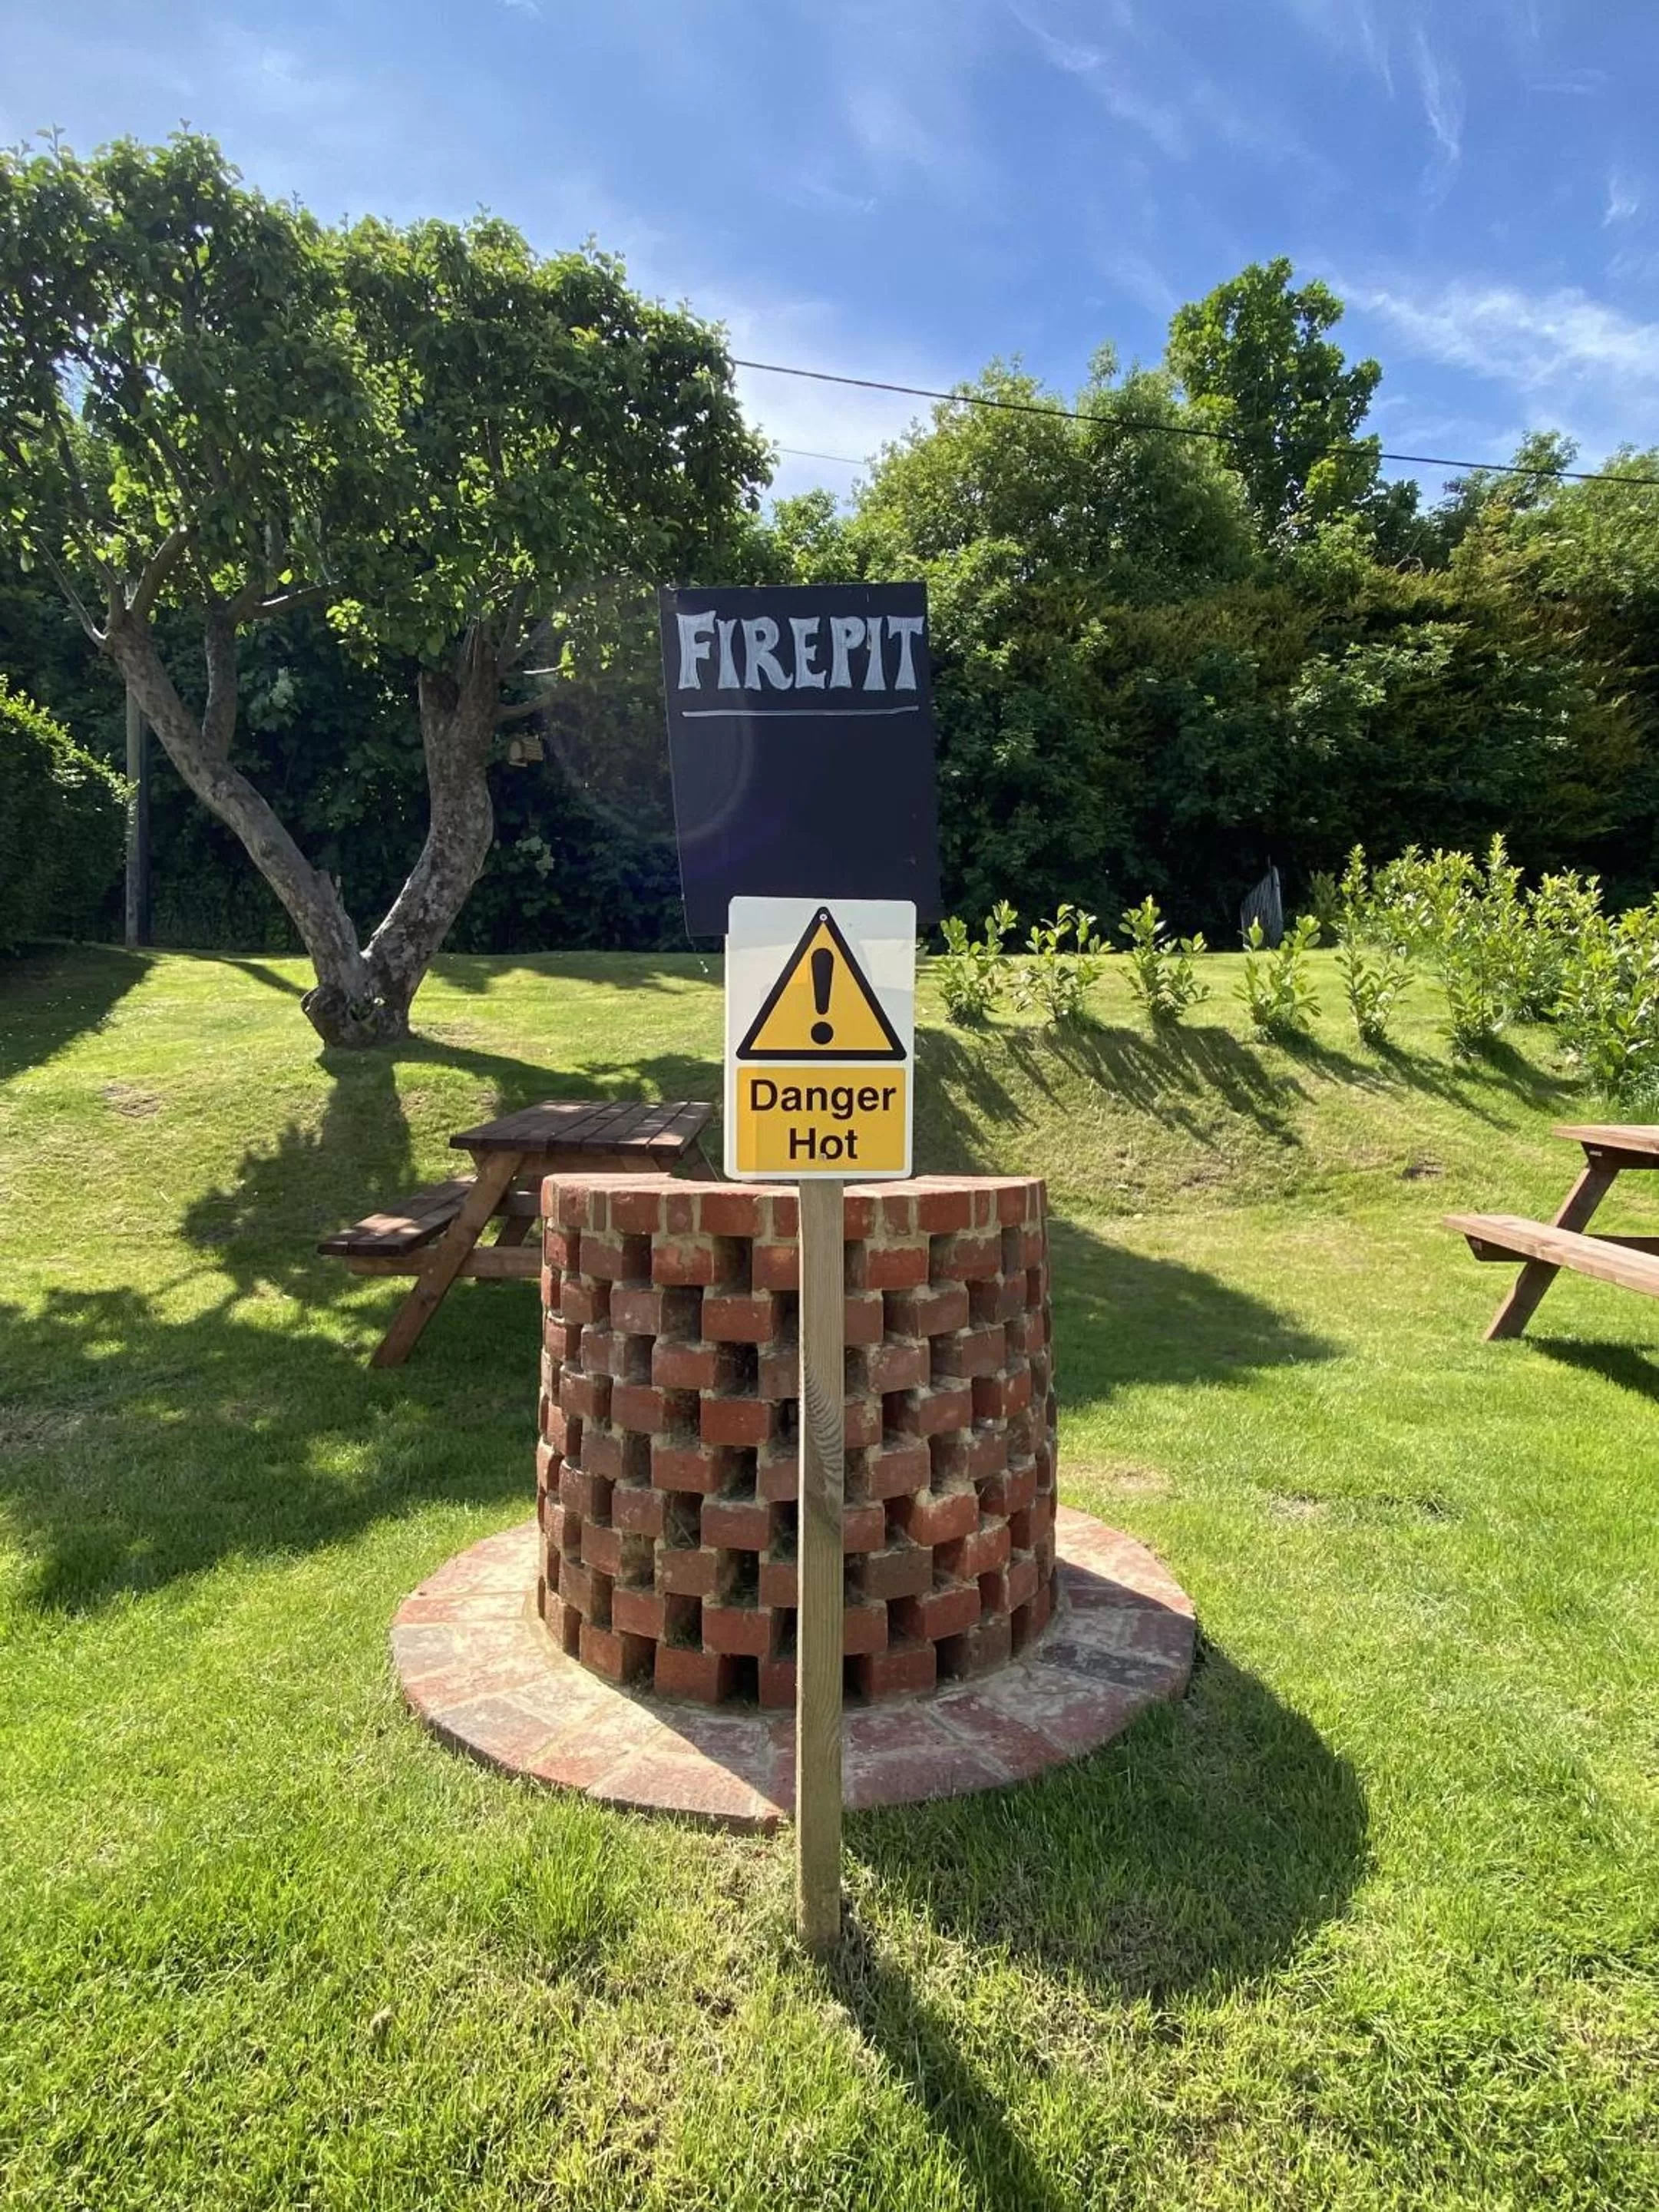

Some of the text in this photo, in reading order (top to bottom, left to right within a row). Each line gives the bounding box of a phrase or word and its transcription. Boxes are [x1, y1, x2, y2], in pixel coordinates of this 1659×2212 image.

[676, 610, 924, 690] FIREPIT
[750, 1080, 897, 1119] Danger
[789, 1128, 858, 1159] Hot
